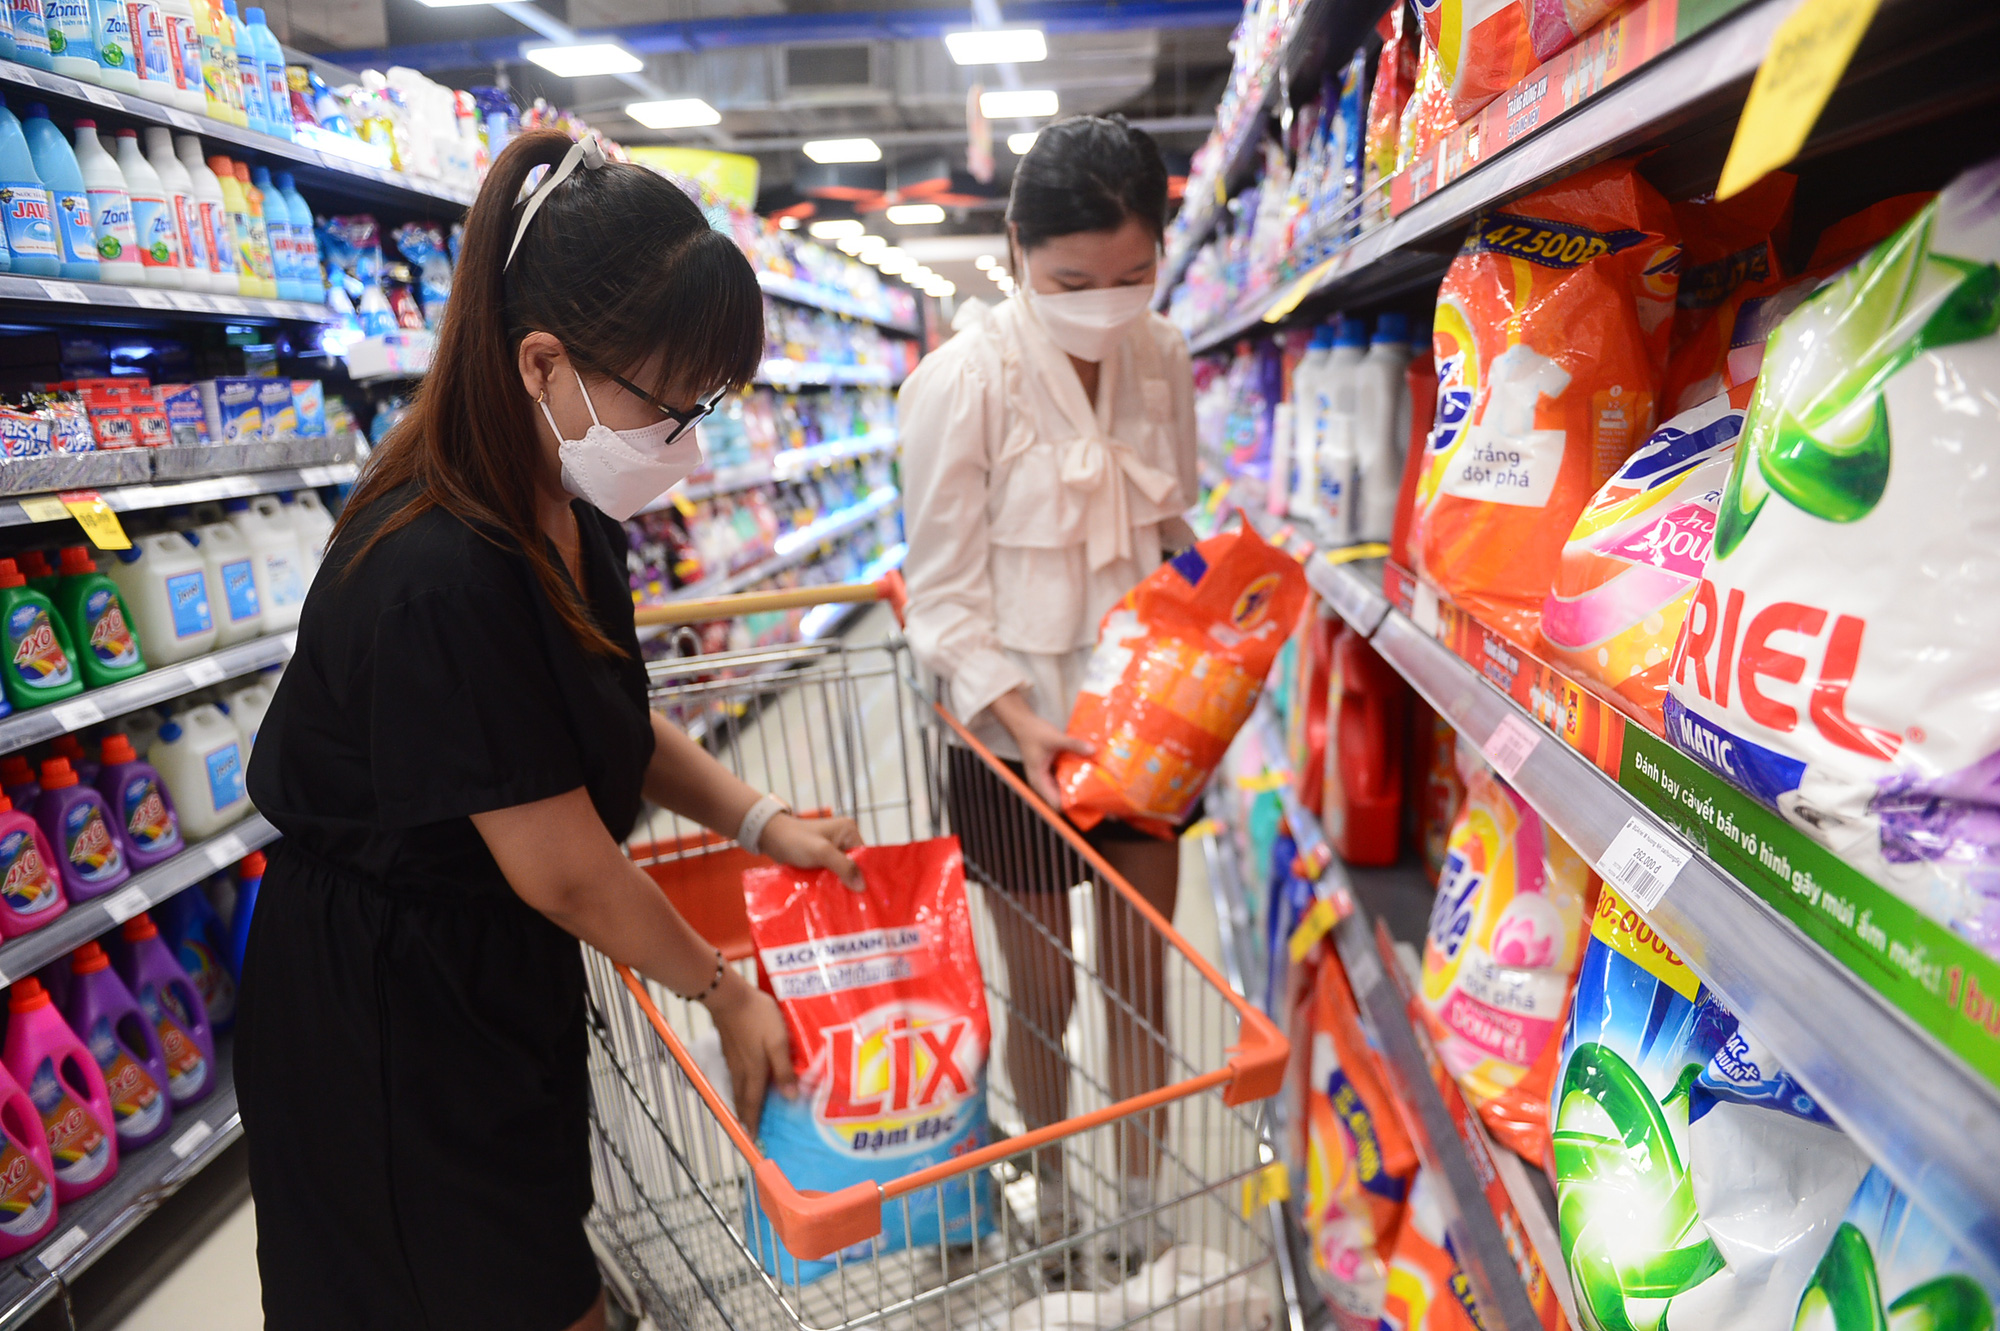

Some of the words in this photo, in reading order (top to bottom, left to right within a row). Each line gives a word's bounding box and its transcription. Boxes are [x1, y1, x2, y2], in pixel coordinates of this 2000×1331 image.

[1496, 469, 1529, 488] phá
[1680, 713, 1735, 776] MATIC
[1632, 847, 1657, 870] 262.000
[1635, 751, 1659, 783] Đánh
[1661, 771, 1680, 800] bay
[1694, 797, 1715, 825] vết
[1716, 809, 1740, 844] bẩn
[1740, 832, 1758, 856] vô
[1759, 840, 1792, 882] hình
[1791, 870, 1822, 907] gây
[1821, 890, 1856, 929] mùi
[1947, 965, 1963, 1009] 1
